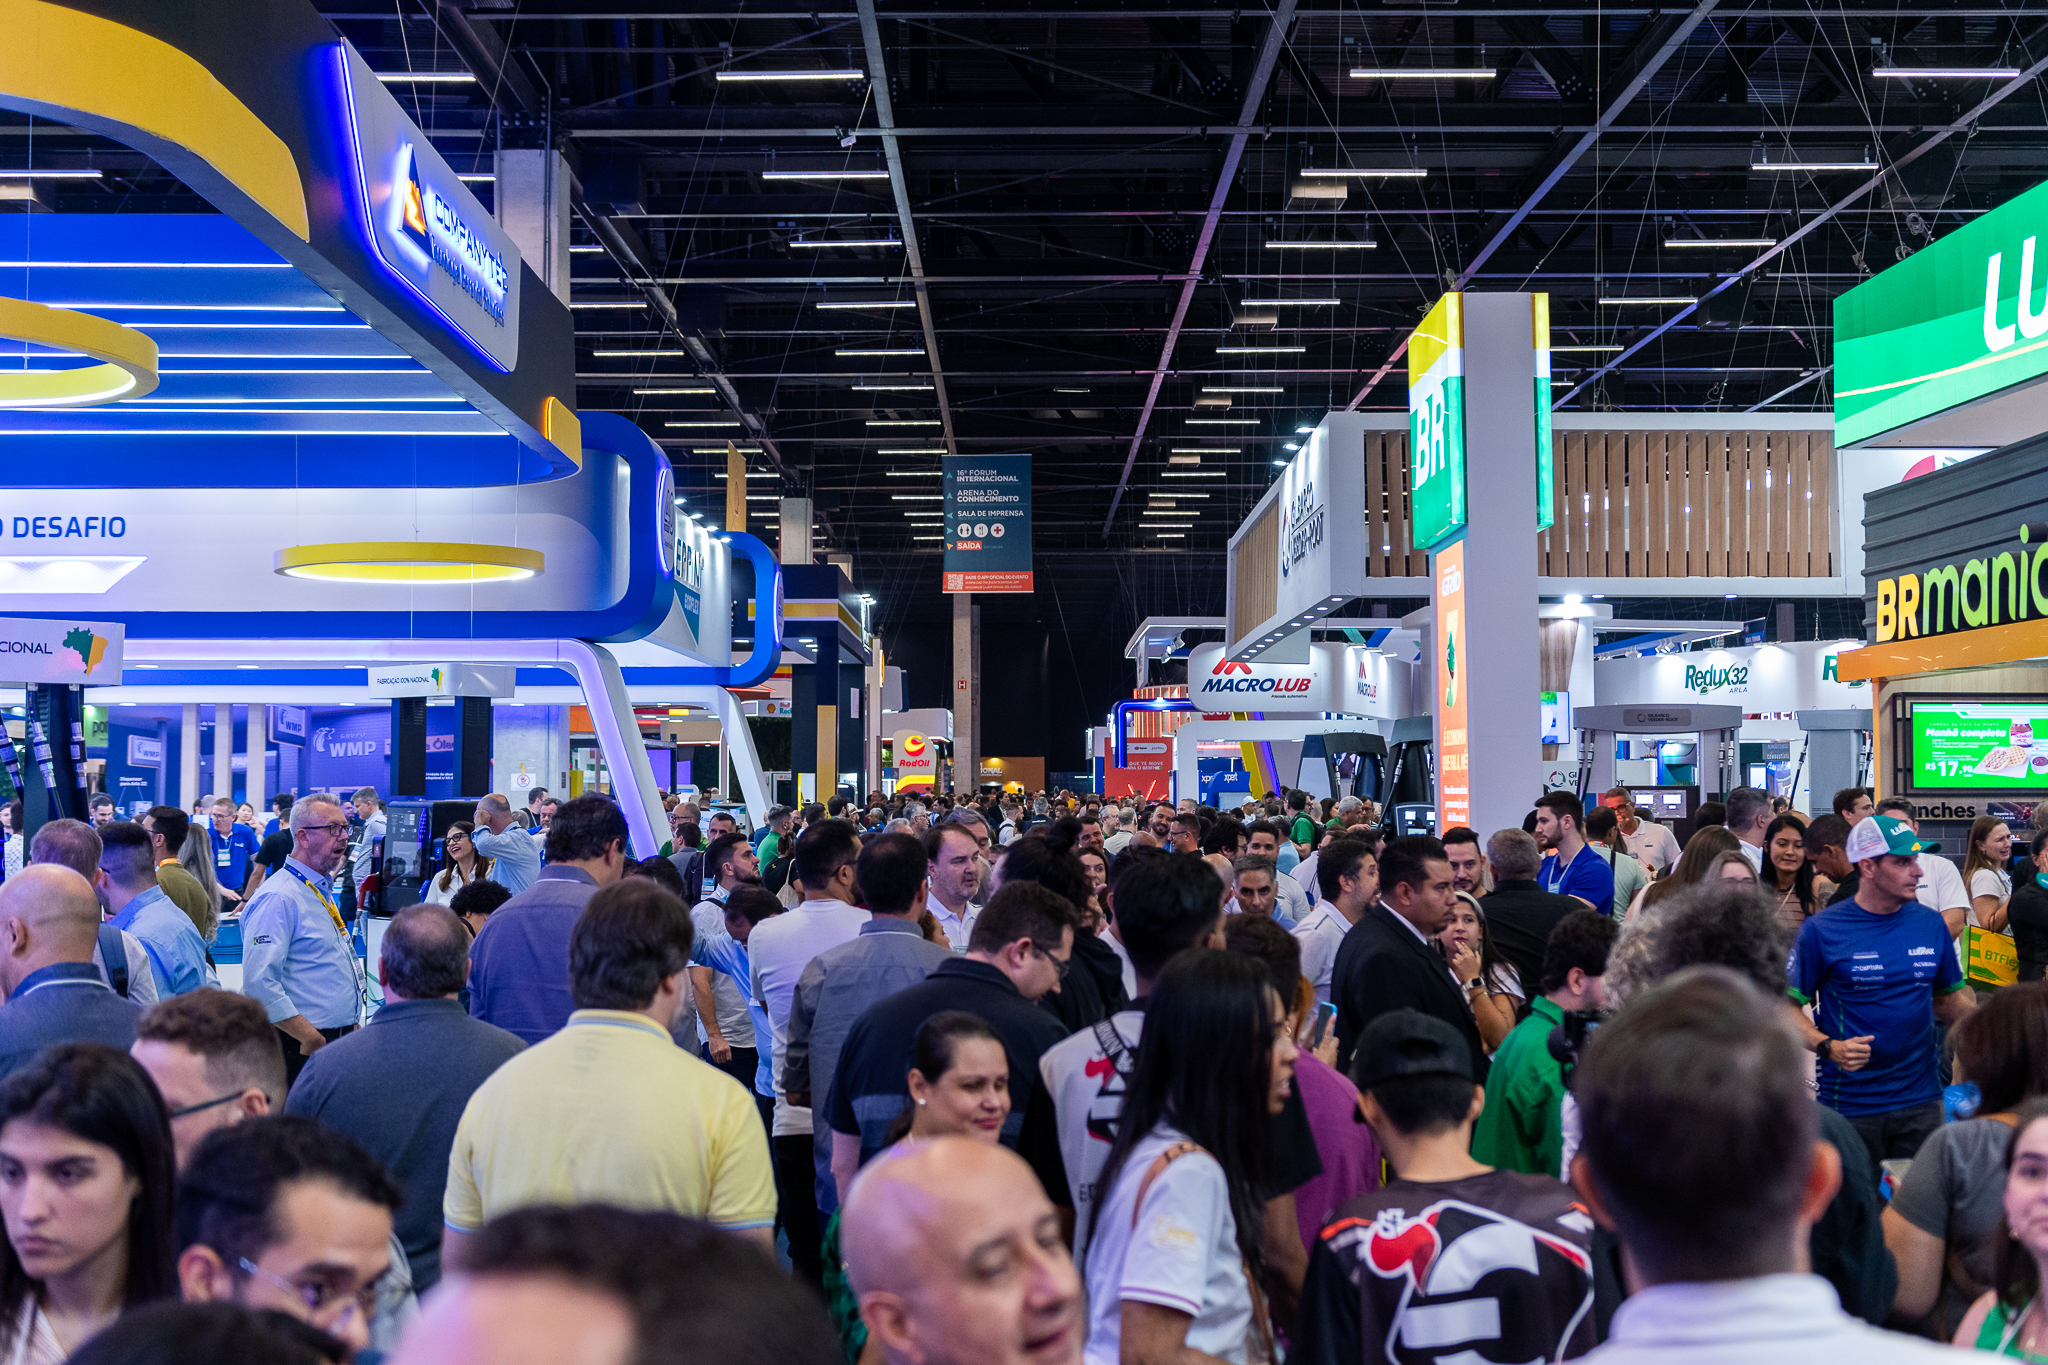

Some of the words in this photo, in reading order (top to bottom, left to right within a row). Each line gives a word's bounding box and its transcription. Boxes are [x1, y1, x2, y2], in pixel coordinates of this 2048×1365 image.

[1415, 381, 1446, 490] BR
[13, 516, 126, 538] DESAFIO
[1442, 570, 1461, 597] GRID
[377, 676, 400, 685] FABRICAÇÃO
[1201, 678, 1312, 693] MACROLUB
[1357, 681, 1377, 698] MACROLUB
[285, 720, 302, 733] WMP
[1925, 727, 1959, 737] Manhã
[1960, 727, 2007, 739] completa
[329, 741, 377, 758] WMP
[899, 759, 930, 767] RodOil
[1925, 762, 1937, 771] R$
[1224, 772, 1238, 784] xpert
[1914, 801, 1976, 818] nches
